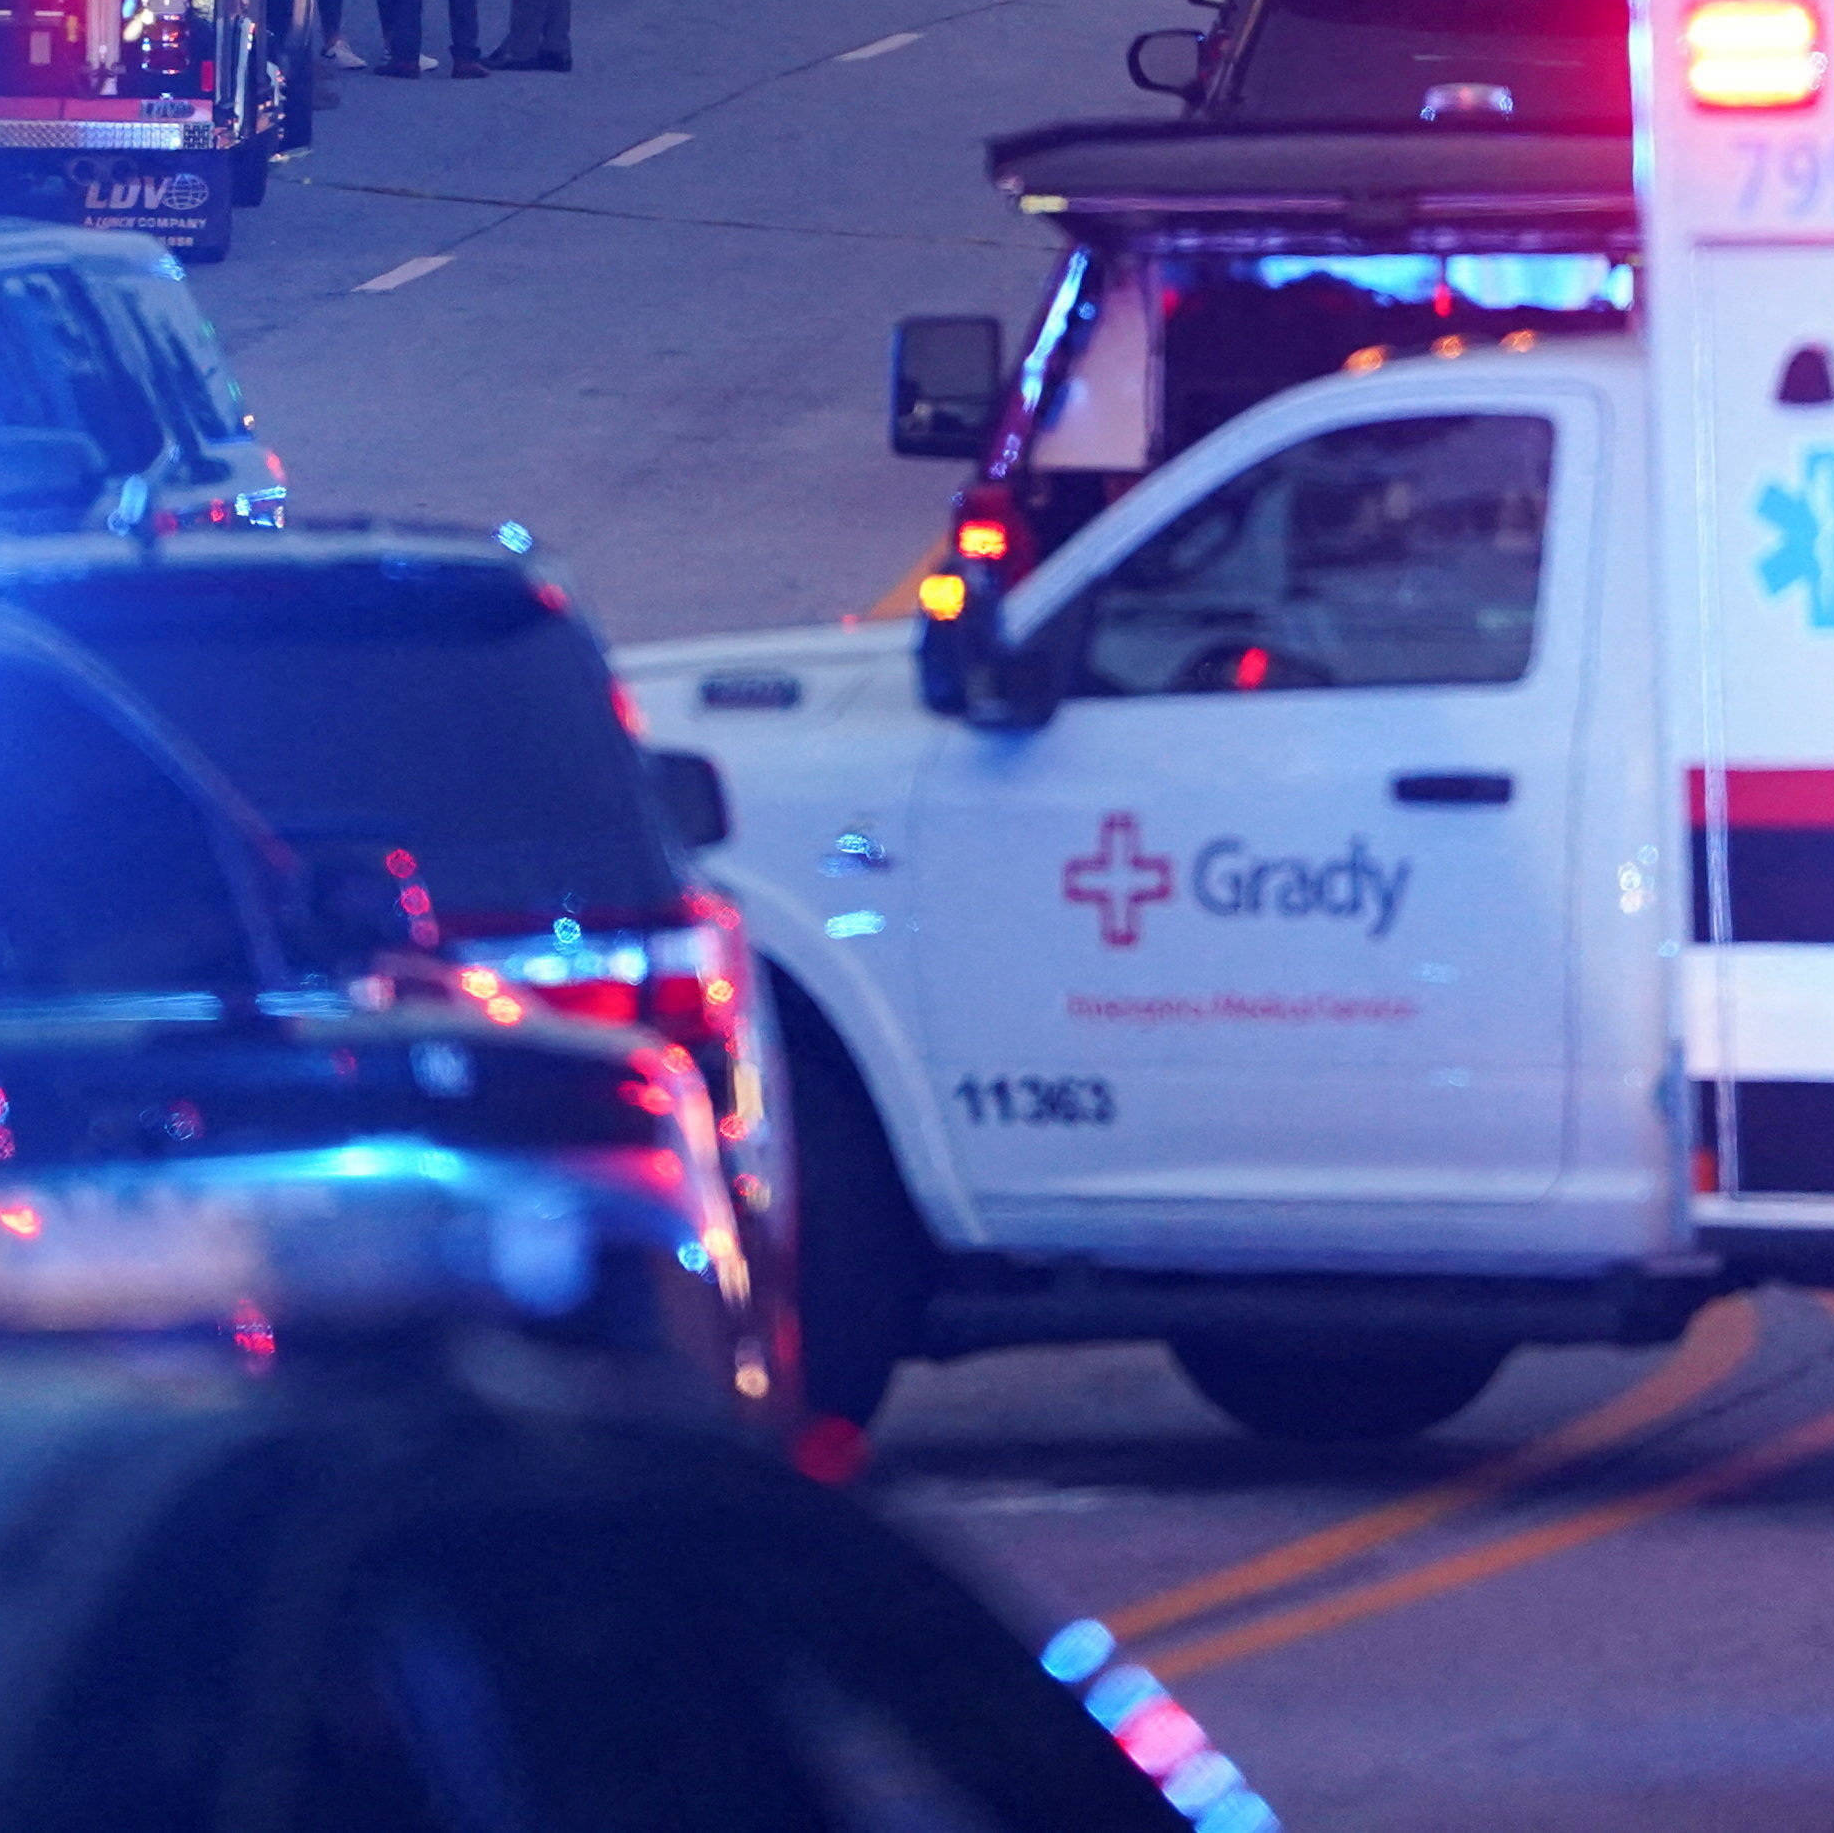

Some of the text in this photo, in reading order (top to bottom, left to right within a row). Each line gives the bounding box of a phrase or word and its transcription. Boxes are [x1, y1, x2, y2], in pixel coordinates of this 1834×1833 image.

[84, 176, 172, 209] LDV
[138, 217, 206, 228] COMPANY
[1192, 834, 1413, 938] Grady
[953, 1072, 1116, 1125] 11363
